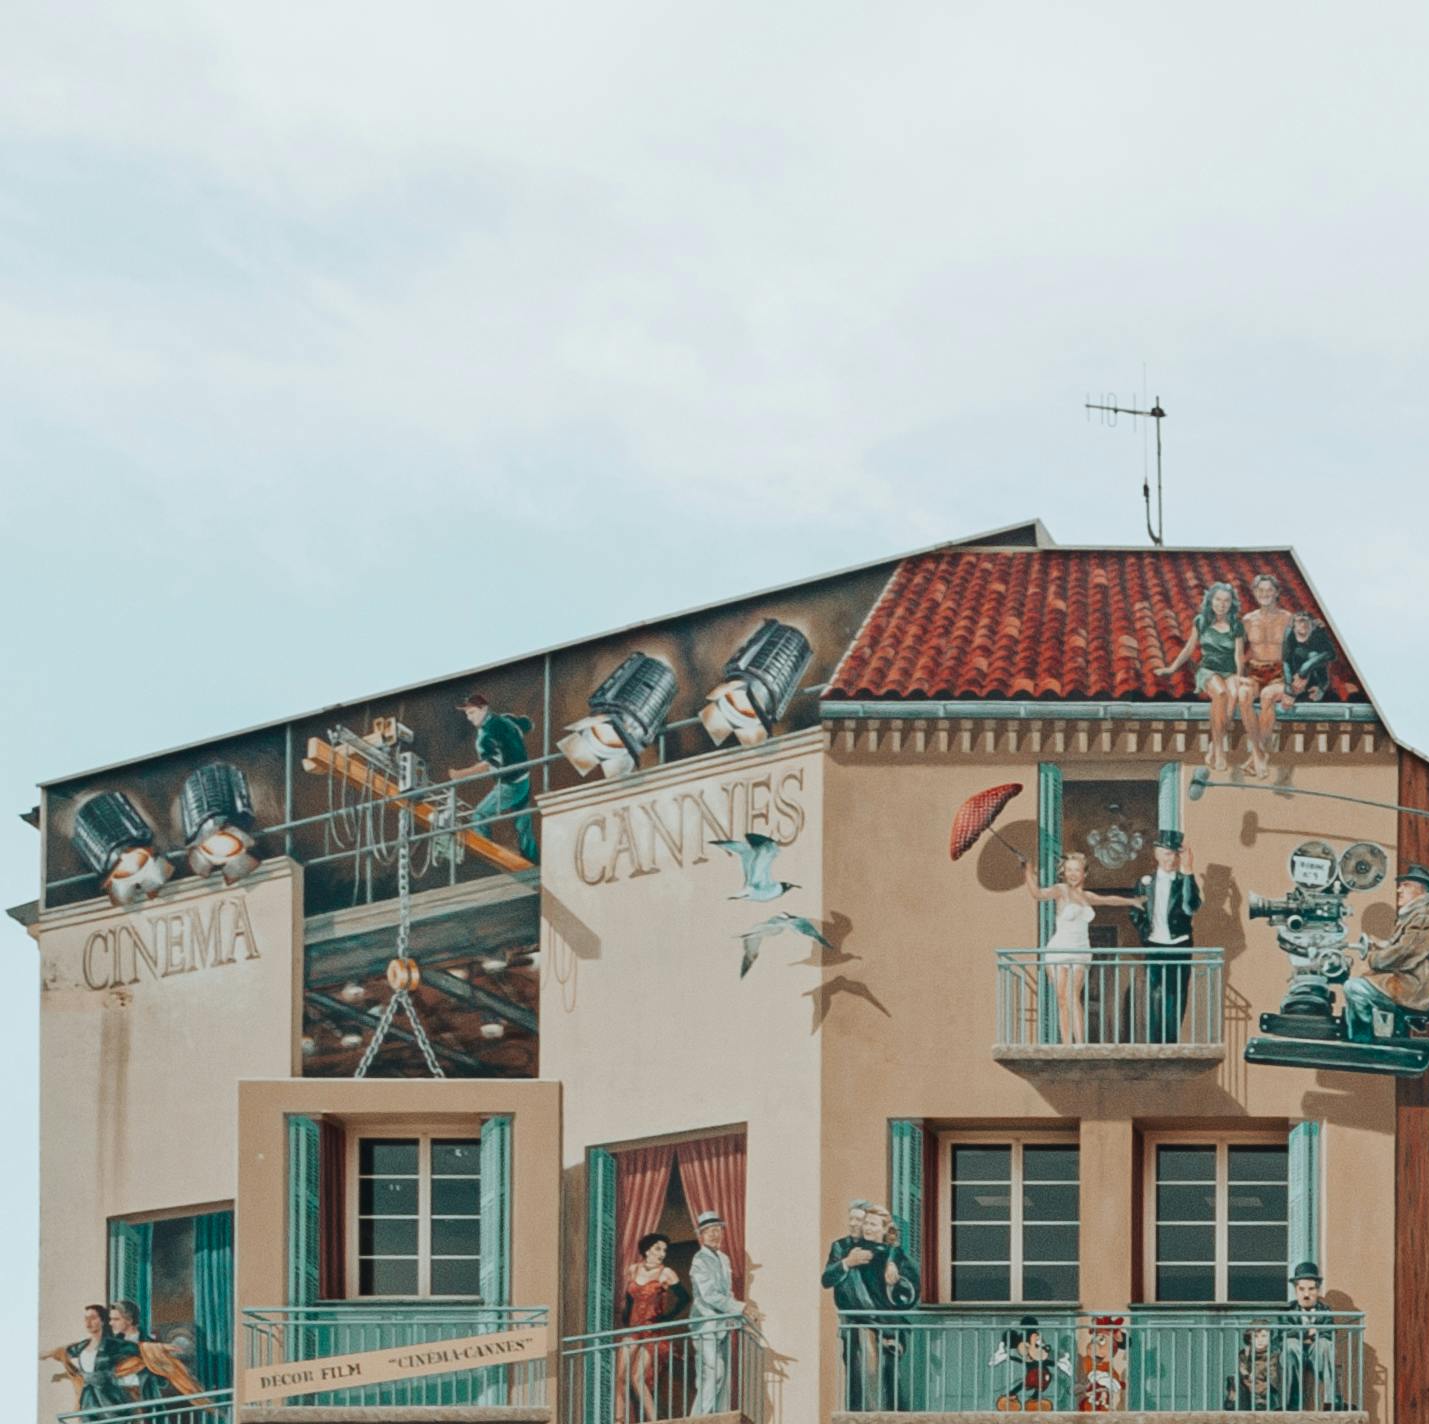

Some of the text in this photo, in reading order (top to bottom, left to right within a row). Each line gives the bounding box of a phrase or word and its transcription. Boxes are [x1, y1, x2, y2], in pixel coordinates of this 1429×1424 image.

[574, 768, 805, 886] CANNES
[82, 895, 261, 991] CINEMA
[320, 1363, 361, 1381] FILM
